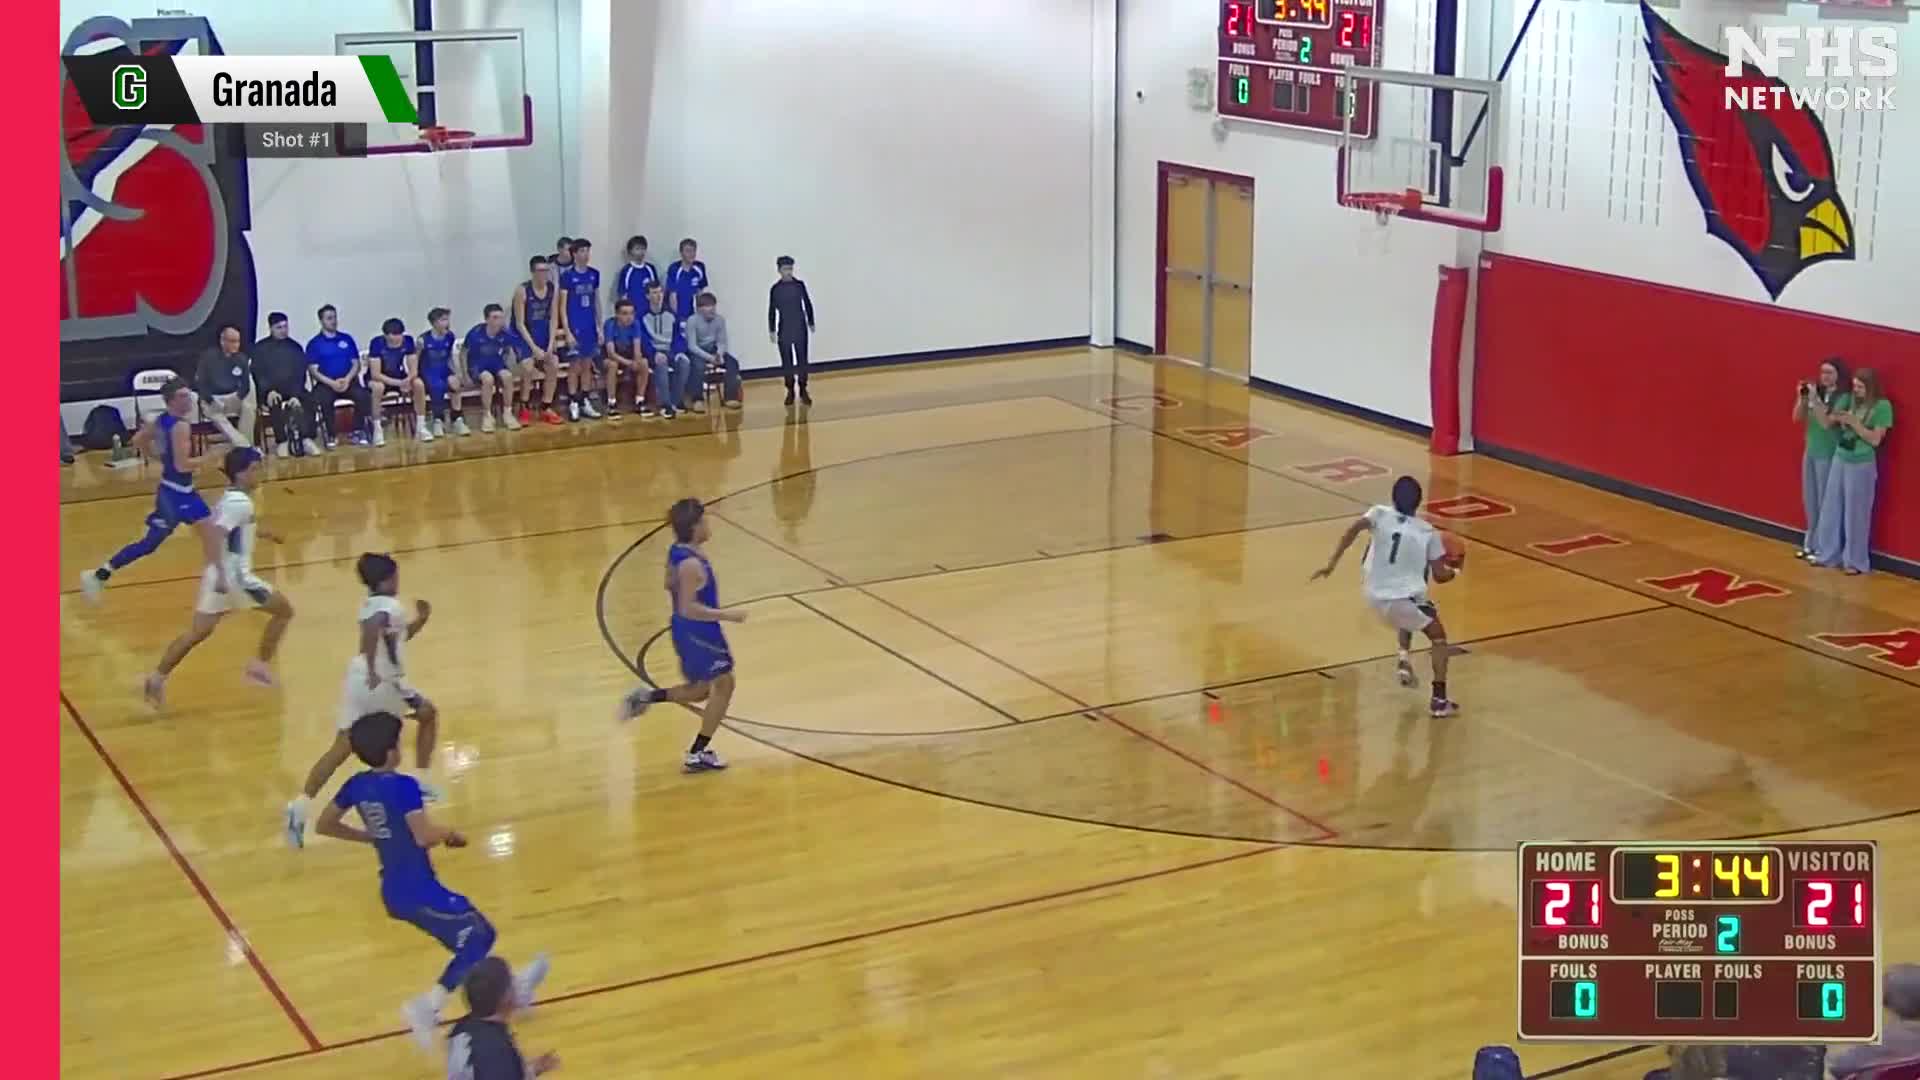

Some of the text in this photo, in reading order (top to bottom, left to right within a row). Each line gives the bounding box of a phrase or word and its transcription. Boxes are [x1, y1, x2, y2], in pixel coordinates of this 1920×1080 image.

[1228, 4, 1253, 36] 21
[1341, 13, 1370, 47] 21
[1300, 36, 1312, 63] 2
[1238, 78, 1249, 104] 0
[1388, 532, 1402, 564] 1
